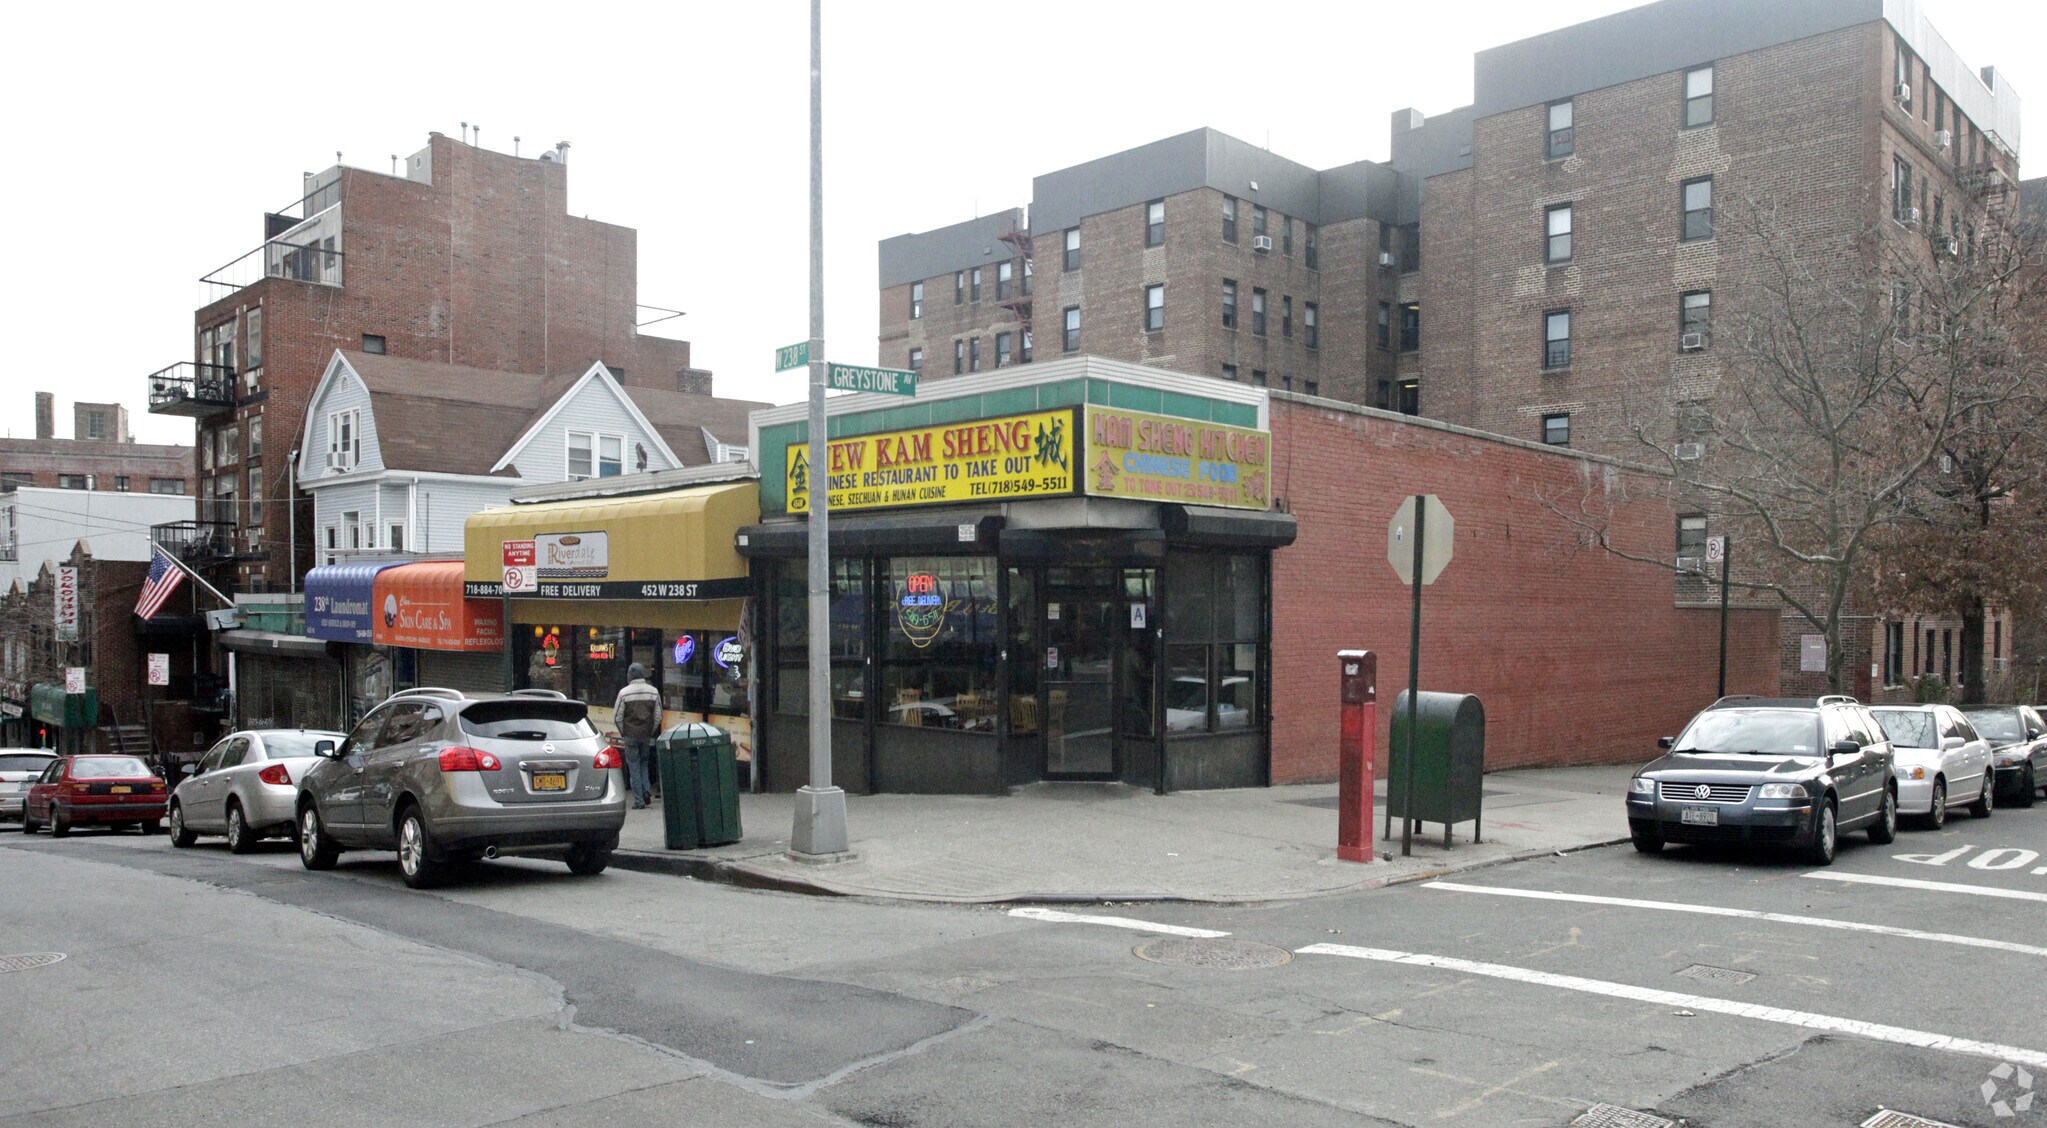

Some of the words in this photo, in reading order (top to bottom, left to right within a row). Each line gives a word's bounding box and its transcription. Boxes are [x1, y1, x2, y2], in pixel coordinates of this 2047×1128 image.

[776, 349, 783, 370] W
[784, 347, 798, 367] 238
[800, 344, 806, 355] ST
[834, 367, 898, 391] GREYSTONE
[903, 374, 912, 384] AV
[827, 441, 867, 472] EW
[876, 433, 932, 468] KAM
[943, 420, 1031, 460] SHENG
[1094, 413, 1133, 449] KAM
[1139, 420, 1196, 456] SHENG
[1200, 428, 1266, 465] KITCHEN
[863, 465, 938, 488] RESTAURANT
[944, 463, 959, 480] TO
[966, 459, 997, 478] TAKE
[1005, 456, 1031, 474] OUT
[1092, 450, 1119, 490] 金
[1123, 451, 1191, 479] CHINESE
[1199, 461, 1238, 484] FOOD
[848, 490, 880, 505] SZECHUAN
[884, 490, 889, 501] &
[893, 487, 916, 501] HUNAN
[919, 485, 946, 500] CUISINE
[1124, 476, 1137, 492] TO
[1140, 478, 1162, 495] TAKE
[1166, 481, 1182, 497] OUT
[551, 544, 594, 564] Riverdale
[541, 585, 559, 596] FREE
[563, 585, 601, 596] DELIVERY
[641, 584, 657, 596] 452
[659, 585, 668, 595] W
[669, 584, 685, 596] 238
[687, 584, 698, 596] ST
[909, 575, 934, 593] OPEN
[331, 597, 368, 615] Laundromat
[1134, 608, 1143, 621] A
[400, 609, 416, 628] SKIN
[415, 610, 432, 629] CARE
[439, 611, 452, 630] SPA
[474, 618, 497, 626] WAXING
[465, 638, 504, 646] REFLEXOLOG
[723, 643, 741, 653] BUD
[719, 652, 743, 662] LIGHT
